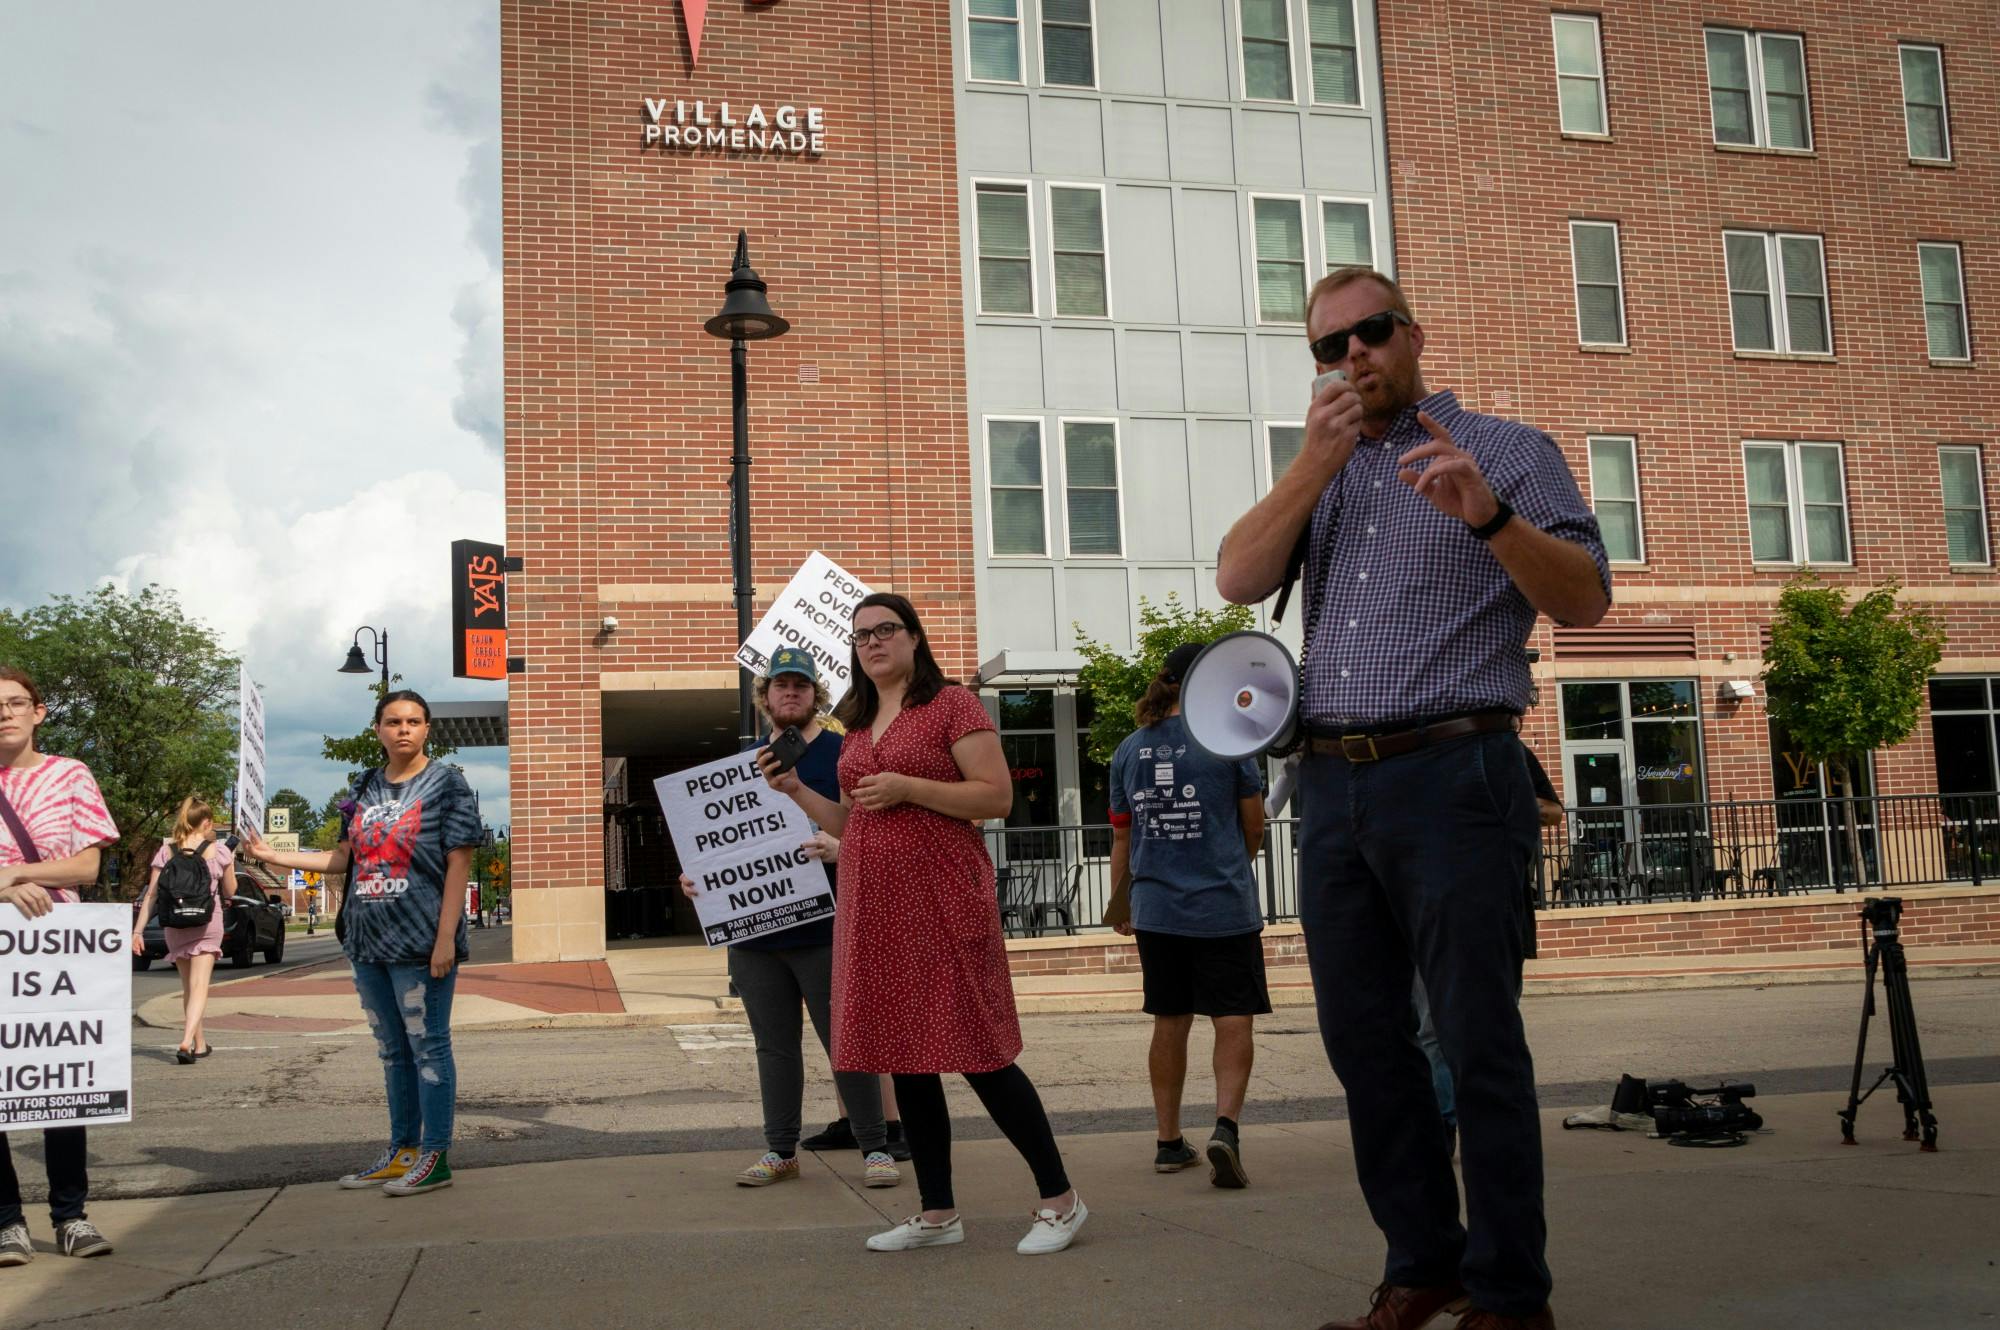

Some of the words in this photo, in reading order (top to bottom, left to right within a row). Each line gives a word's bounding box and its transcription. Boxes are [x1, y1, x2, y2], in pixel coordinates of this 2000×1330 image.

[645, 98, 824, 132] VILLAGE
[646, 125, 825, 152] PROMENADE
[468, 555, 504, 618] YATS
[824, 569, 864, 601] PEOP
[773, 619, 850, 680] HOUSING
[685, 760, 763, 797] PEOPLE
[704, 790, 762, 820] OVER
[695, 811, 787, 852] PROFITS!
[703, 846, 810, 891] HOUSING
[728, 877, 795, 911] NOW!
[709, 930, 728, 943] PSL
[731, 929, 748, 940] AND
[750, 914, 797, 934] LIBERATION
[727, 917, 755, 930] PARTY
[756, 912, 772, 923] FOR
[774, 898, 818, 918] SOCIALISM
[0, 928, 122, 955] OUSING
[12, 971, 42, 997] IS
[51, 970, 76, 996] A
[0, 1019, 103, 1049] UMAN
[0, 1060, 94, 1092] IGHT!
[0, 1099, 21, 1111] RTY
[24, 1098, 46, 1109] FOR
[48, 1093, 110, 1107] SOCIALISM
[10, 1108, 77, 1123] LIBERATION
